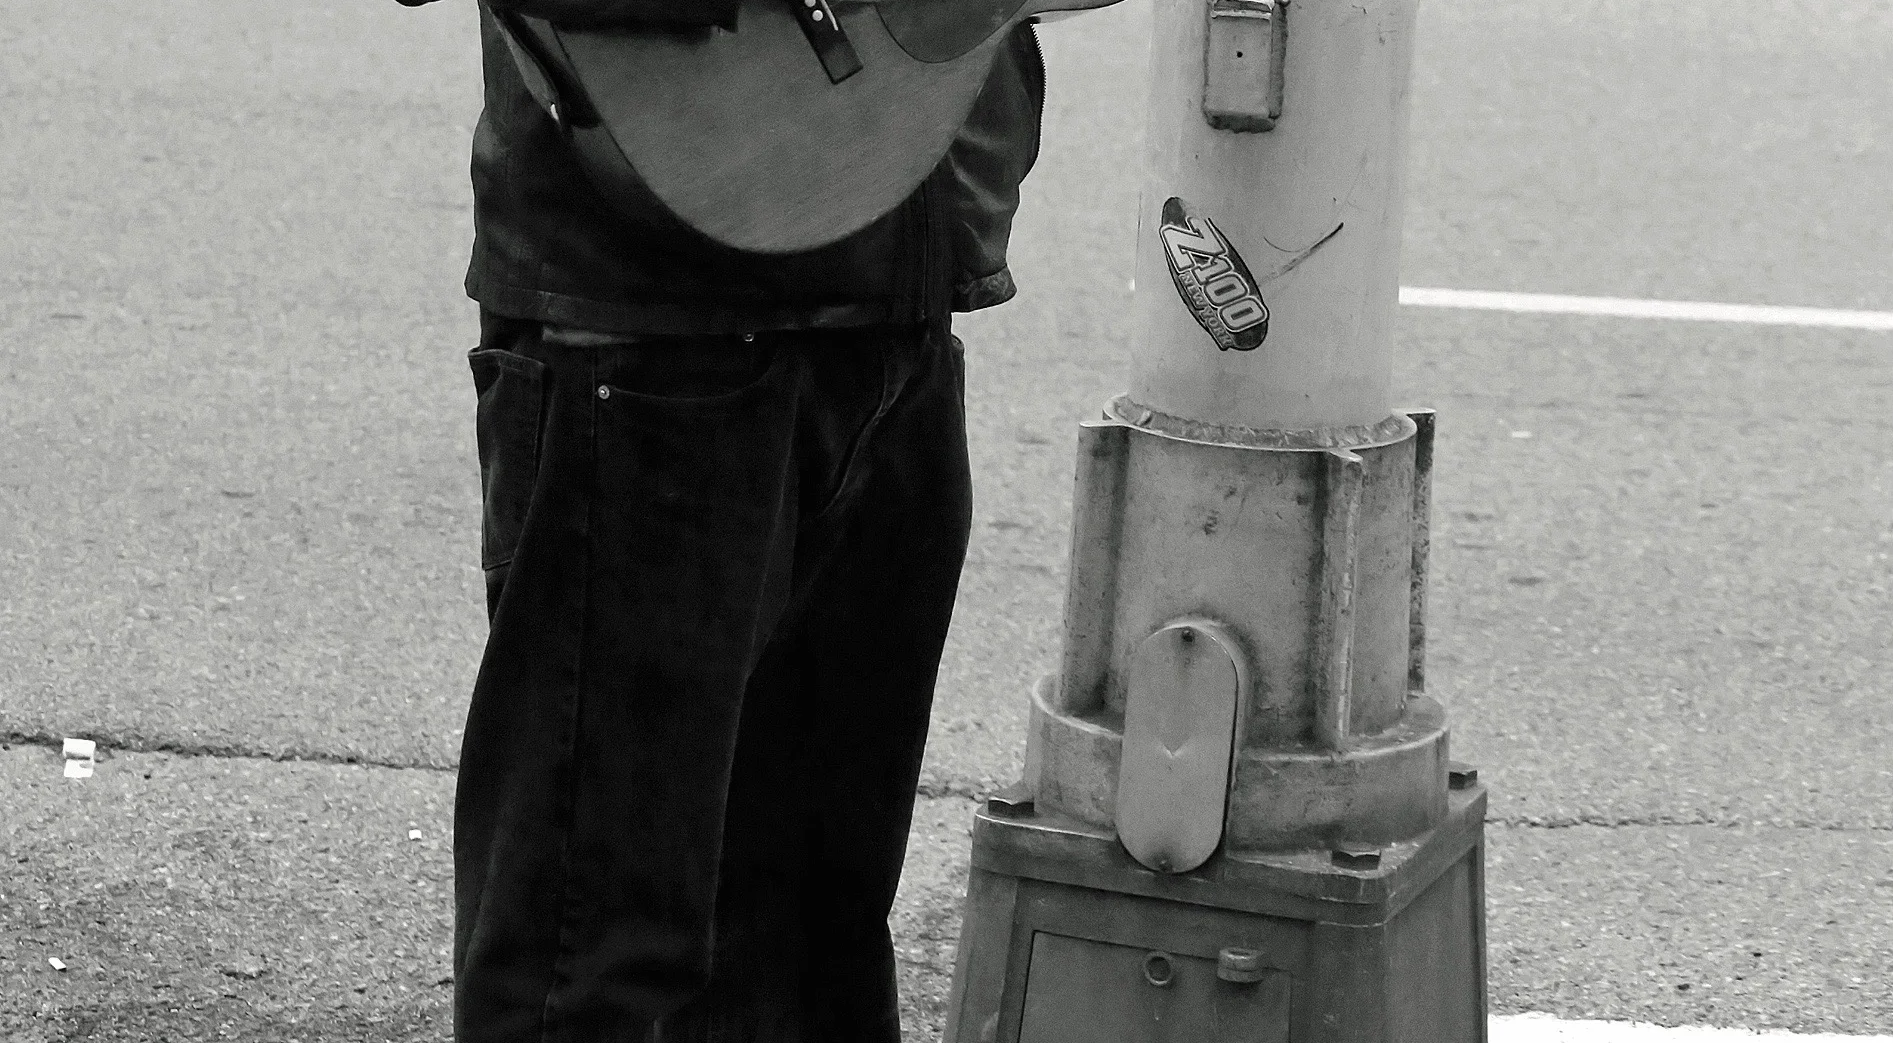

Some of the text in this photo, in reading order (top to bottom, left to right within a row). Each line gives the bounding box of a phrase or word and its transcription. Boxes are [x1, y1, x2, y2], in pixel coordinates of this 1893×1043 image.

[1159, 216, 1269, 333] Z100
[1180, 272, 1233, 346] NEW YORK
